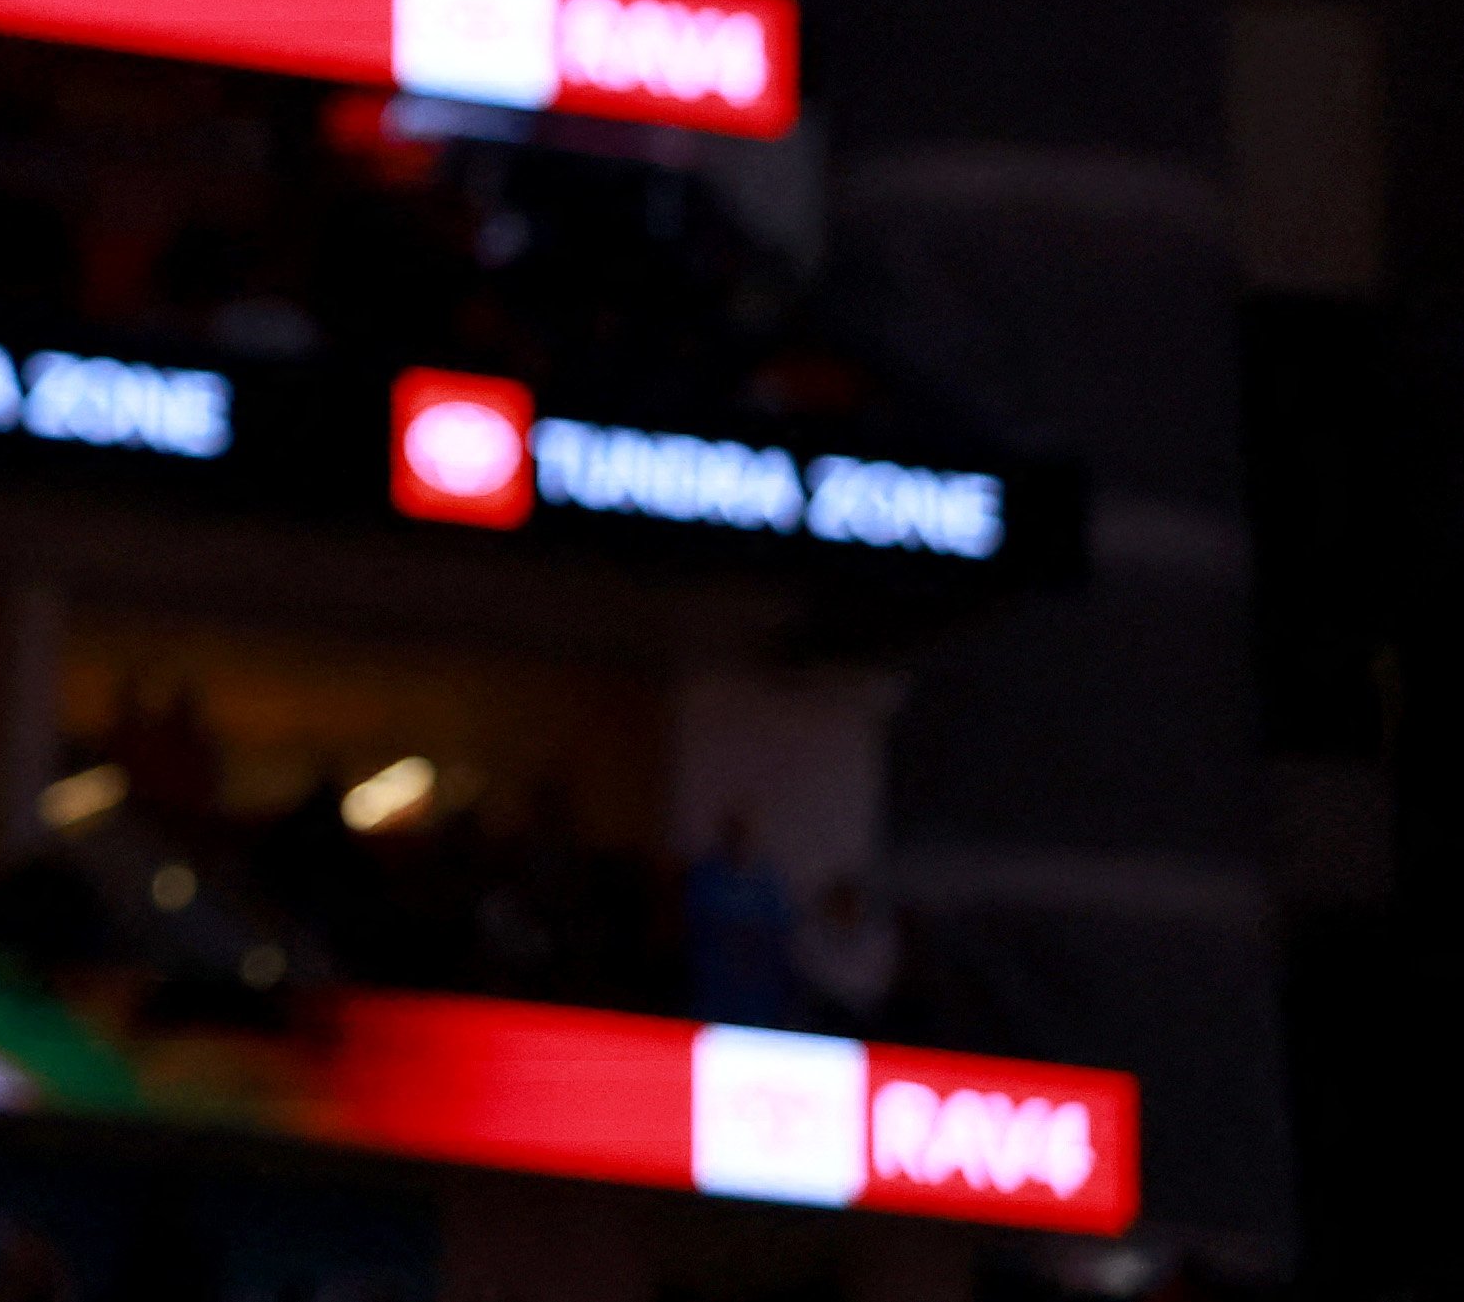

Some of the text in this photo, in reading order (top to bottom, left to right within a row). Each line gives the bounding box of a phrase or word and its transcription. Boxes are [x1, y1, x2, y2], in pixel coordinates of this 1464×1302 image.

[21, 349, 232, 459] ZONE
[527, 416, 1005, 560] TUNDRA ZONE
